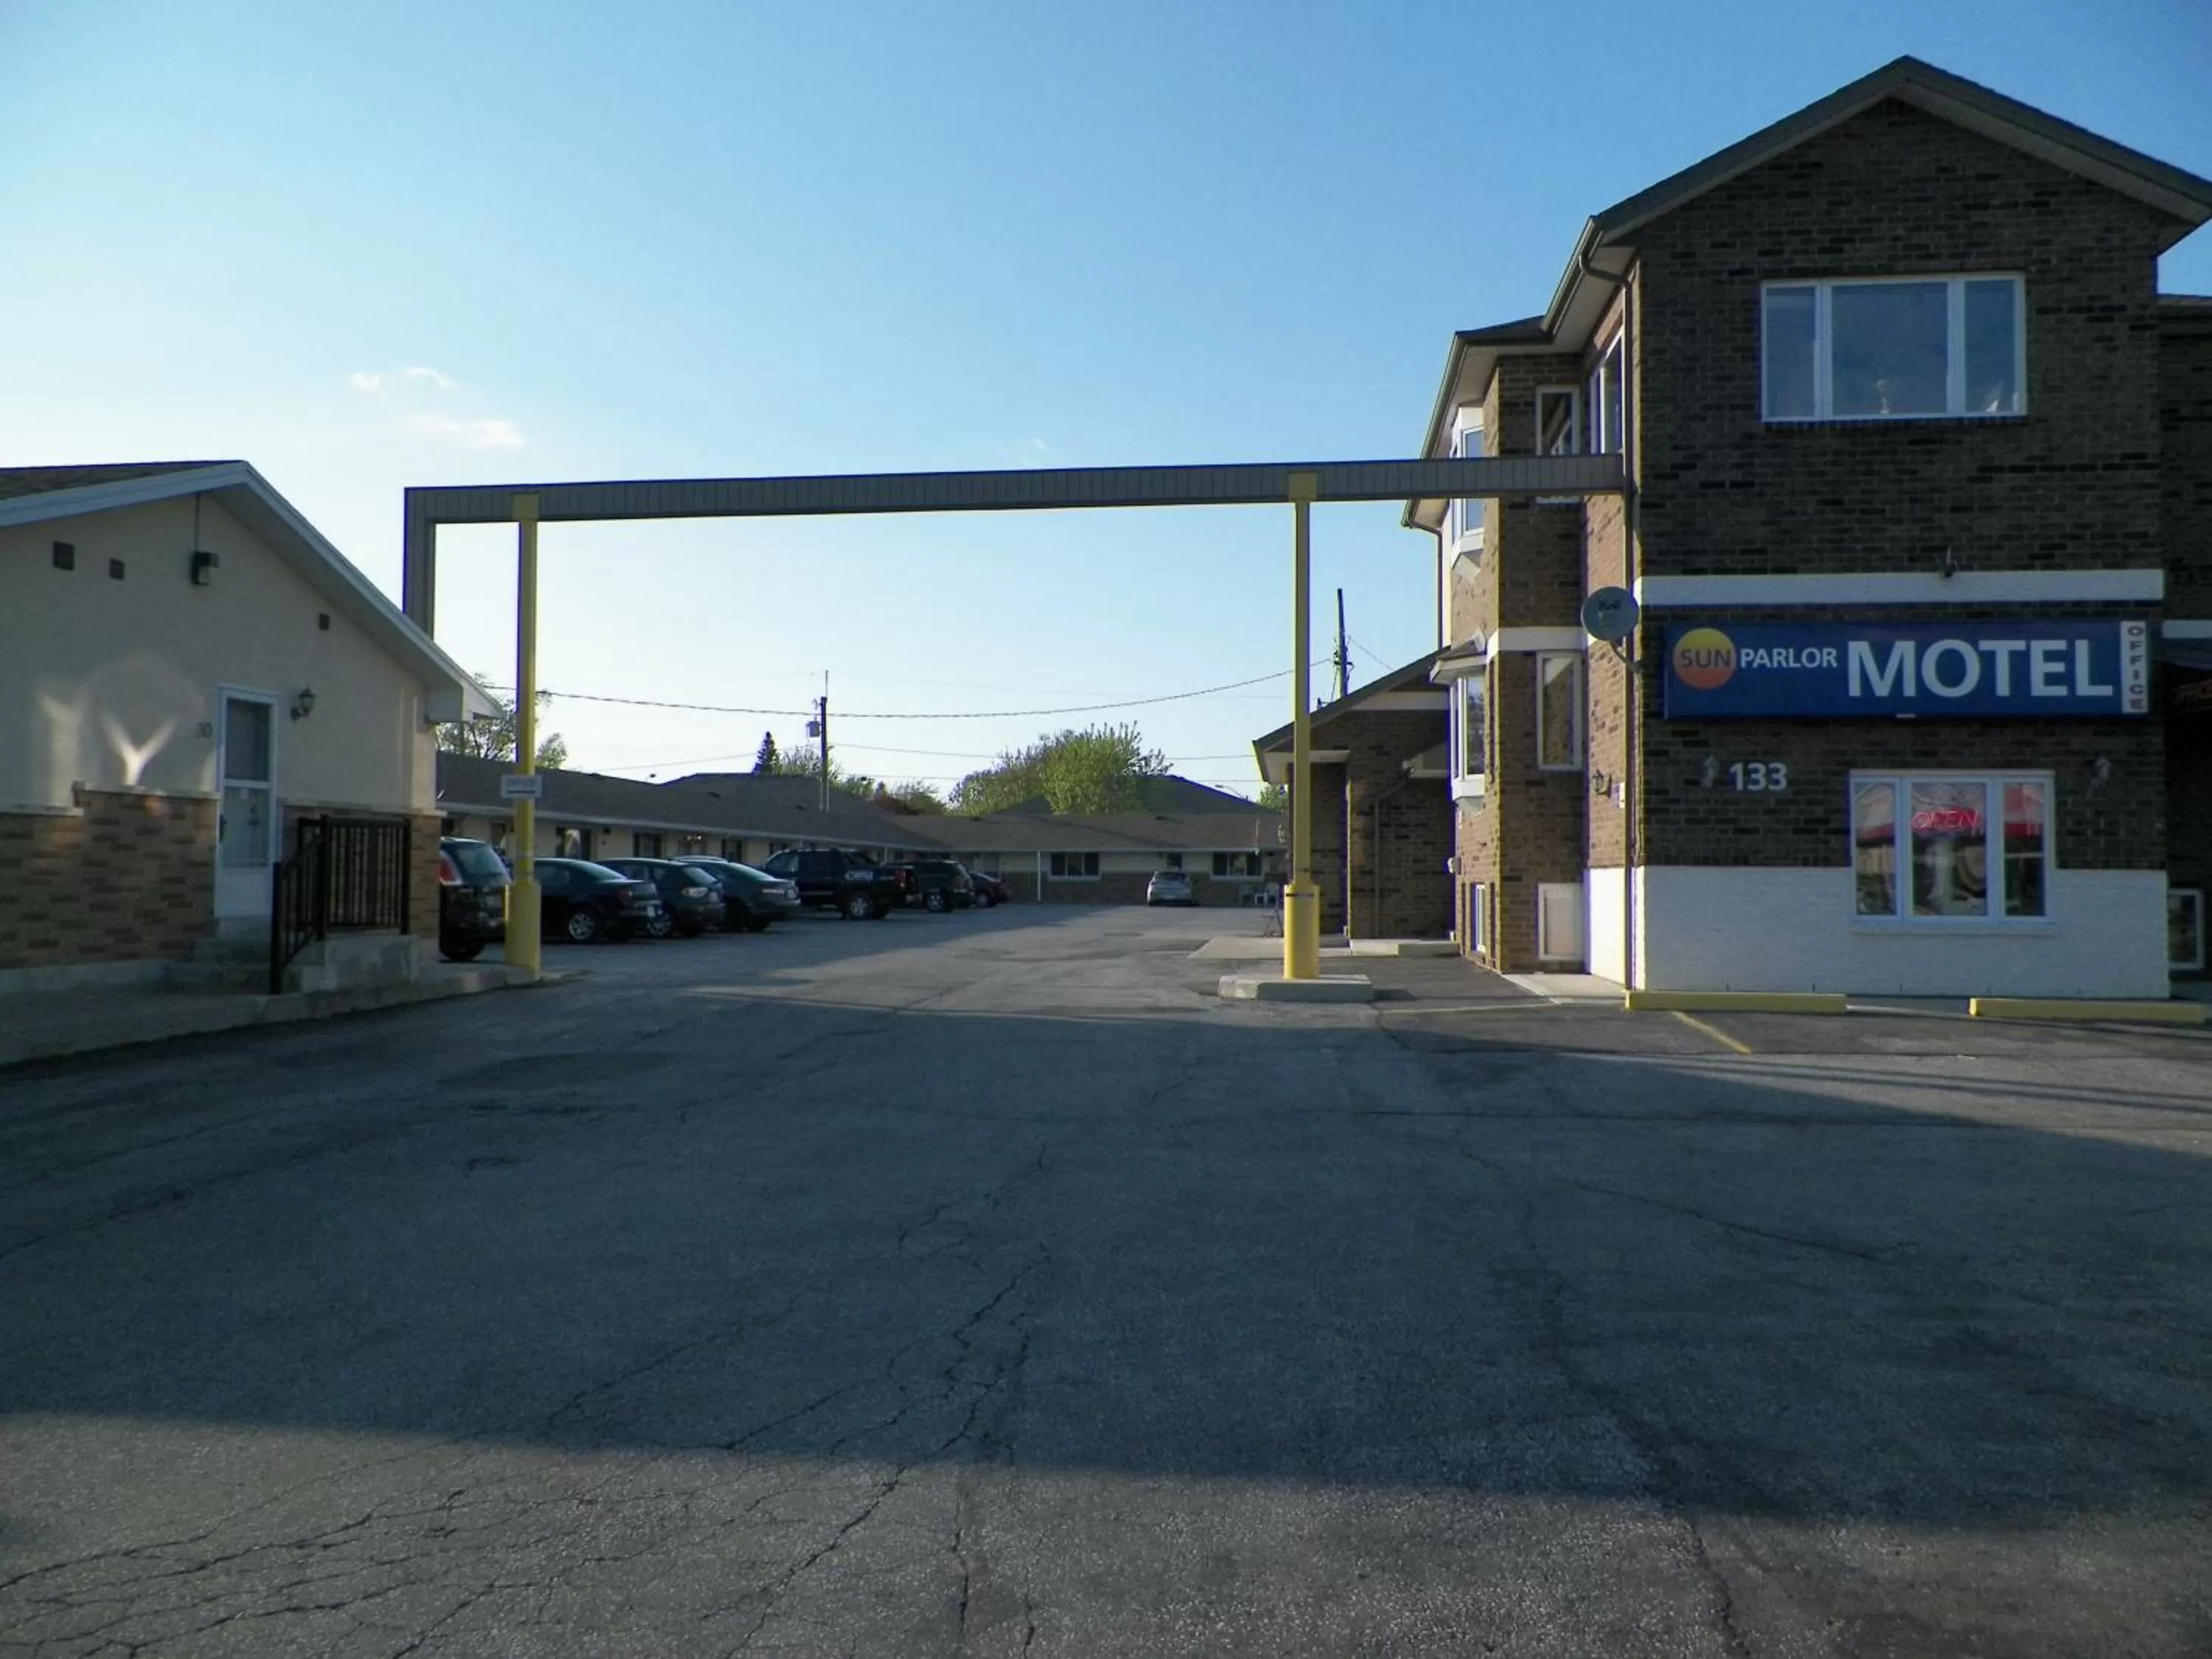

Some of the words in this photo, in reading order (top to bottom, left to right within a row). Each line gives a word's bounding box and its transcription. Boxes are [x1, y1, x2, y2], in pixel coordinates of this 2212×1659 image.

[1679, 648, 1732, 669] SUN
[1739, 647, 1839, 669] PARLOR
[1848, 639, 2114, 698] MOTEL
[2126, 626, 2145, 709] OFFICE
[1729, 762, 1788, 792] 133
[1912, 810, 1979, 829] OPEN
